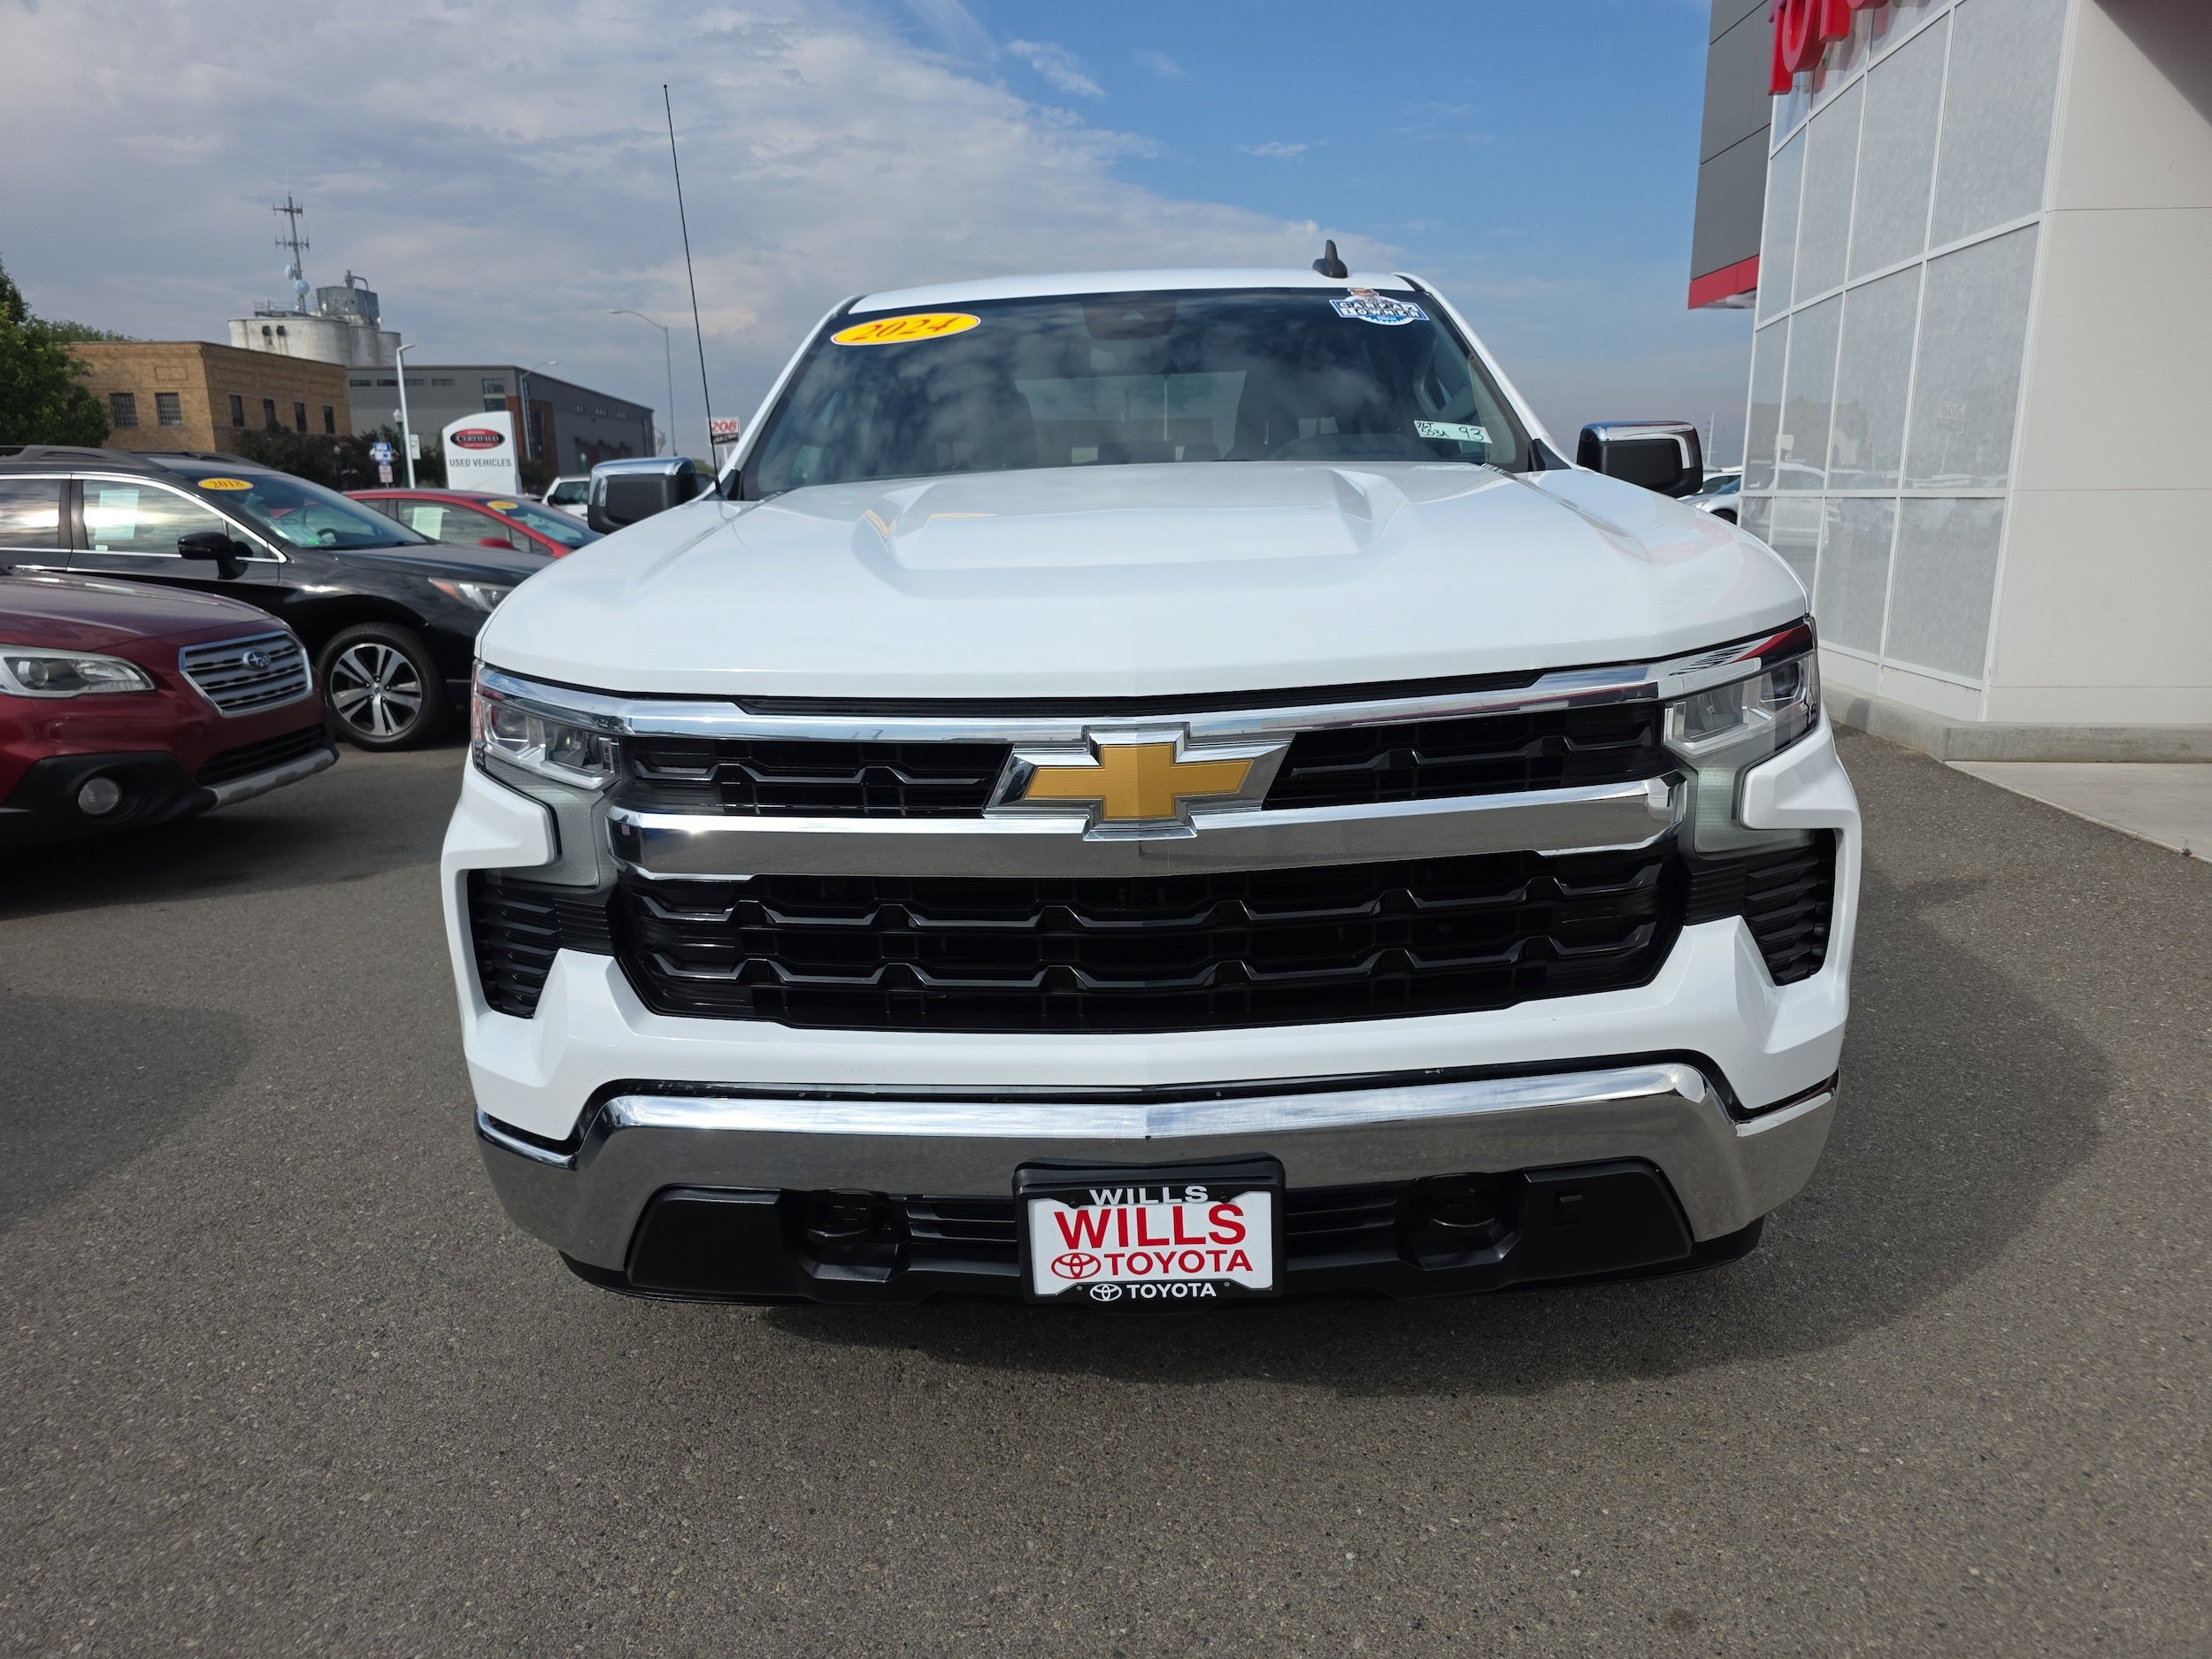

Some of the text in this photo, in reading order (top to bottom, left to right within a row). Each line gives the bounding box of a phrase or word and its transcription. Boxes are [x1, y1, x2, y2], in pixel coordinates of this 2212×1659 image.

[1339, 302, 1419, 312] CARFAX
[1357, 308, 1421, 318] OWNER
[850, 316, 962, 342] 2024
[1459, 426, 1485, 442] 93
[449, 457, 512, 468] USED VEHICLES
[1089, 1185, 1209, 1206] WILLS
[1054, 1202, 1247, 1250] WILLS
[1103, 1249, 1254, 1276] TOYOTA
[1126, 1282, 1217, 1299] TOYOTA
